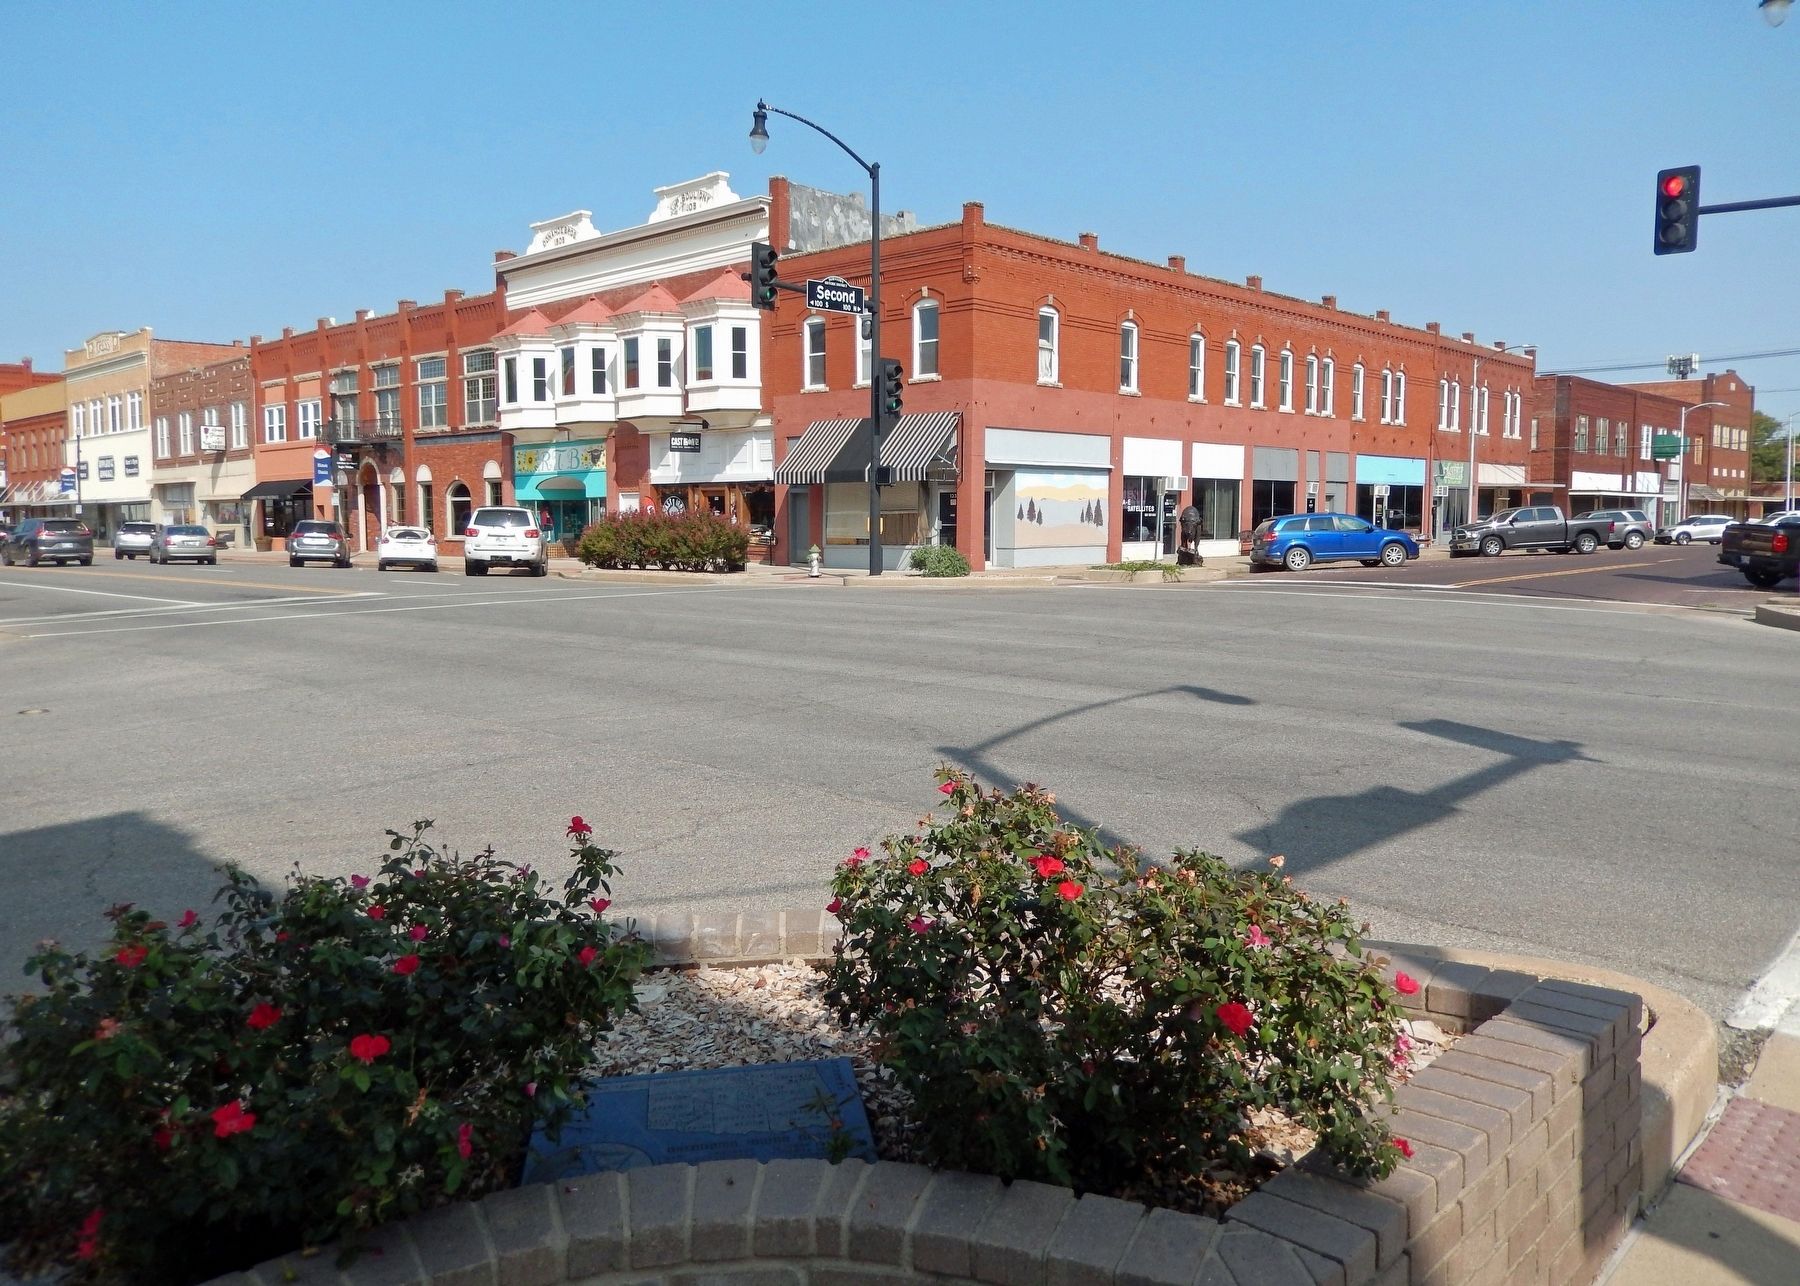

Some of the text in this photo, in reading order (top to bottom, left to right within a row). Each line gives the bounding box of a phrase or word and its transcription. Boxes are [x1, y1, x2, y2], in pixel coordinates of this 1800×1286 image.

[817, 285, 855, 304] Second
[814, 300, 823, 308] 100
[843, 304, 851, 312] 100
[671, 437, 683, 446] CAST
